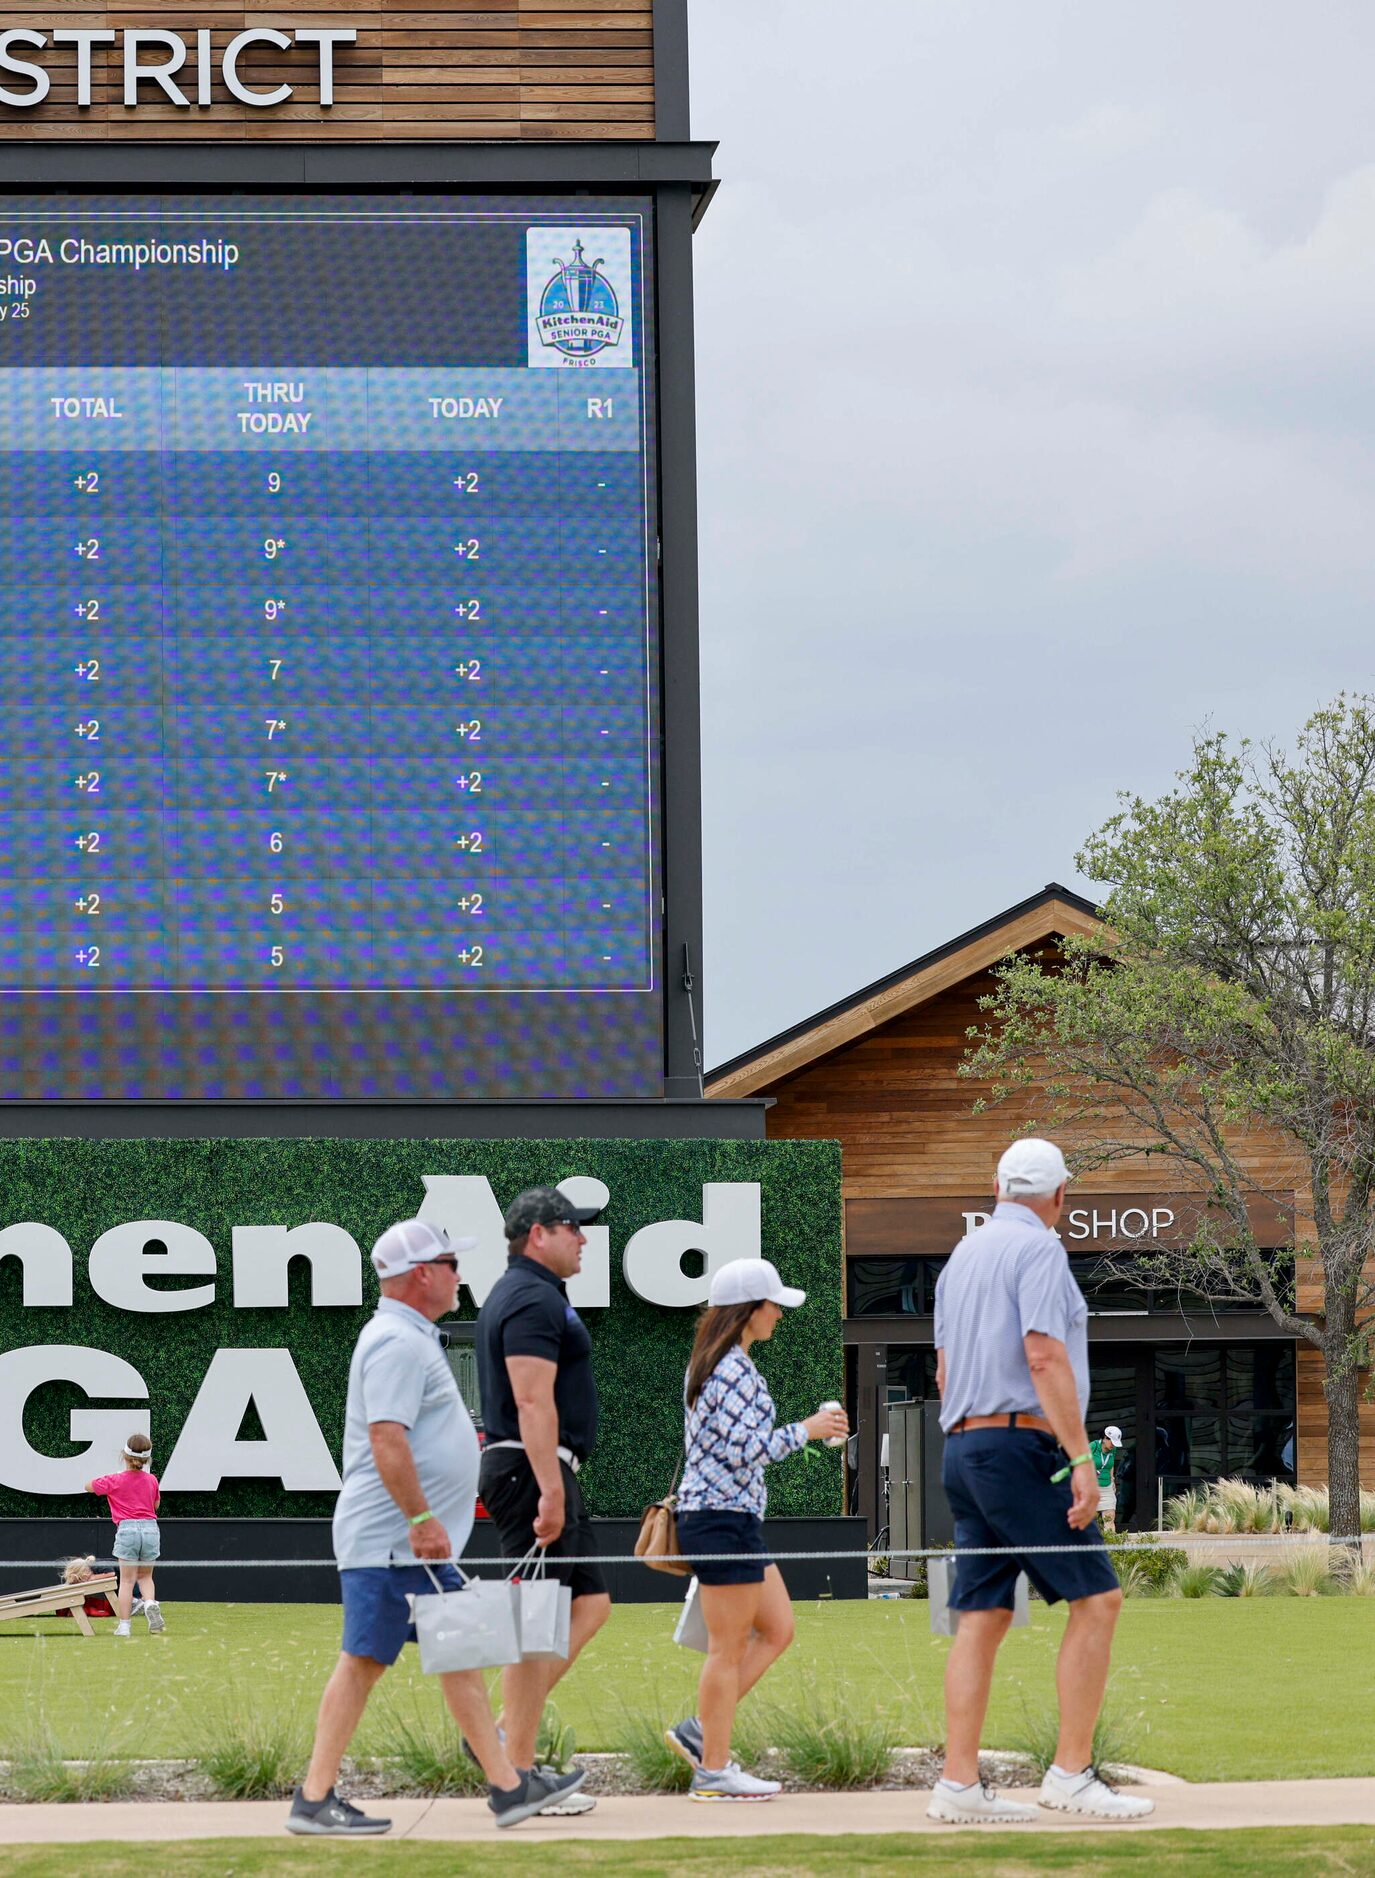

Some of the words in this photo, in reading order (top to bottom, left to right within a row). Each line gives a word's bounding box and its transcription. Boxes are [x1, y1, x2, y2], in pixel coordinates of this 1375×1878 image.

[61, 239, 238, 269] Championship
[12, 303, 29, 318] 25
[542, 315, 619, 329] KitchenAid
[551, 328, 587, 340] SENIOR
[590, 329, 611, 340] PGA
[563, 358, 596, 367] FRISCO
[244, 383, 304, 403] THRU
[51, 398, 122, 418] TOTAL
[429, 398, 503, 418] TODAY
[587, 398, 613, 418] R1
[238, 413, 311, 433] TODAY
[74, 473, 99, 492] +2
[268, 473, 280, 492] 9
[453, 473, 478, 492] +2
[74, 539, 99, 559] +2
[454, 539, 479, 559] +2
[75, 600, 99, 620] +2
[455, 600, 480, 620] +2
[75, 660, 99, 680] +2
[269, 660, 281, 680] 7
[455, 660, 480, 680] +2
[75, 720, 99, 740] +2
[456, 721, 481, 740] +2
[75, 772, 99, 792] +2
[457, 772, 481, 792] +2
[75, 833, 99, 852] +2
[270, 833, 282, 852] 6
[457, 833, 482, 852] +2
[75, 894, 100, 914] +2
[271, 894, 282, 914] 5
[458, 894, 482, 914] +2
[76, 947, 100, 966] +2
[271, 947, 283, 966] 5
[458, 946, 483, 966] +2
[1068, 1208, 1175, 1239] SHOP
